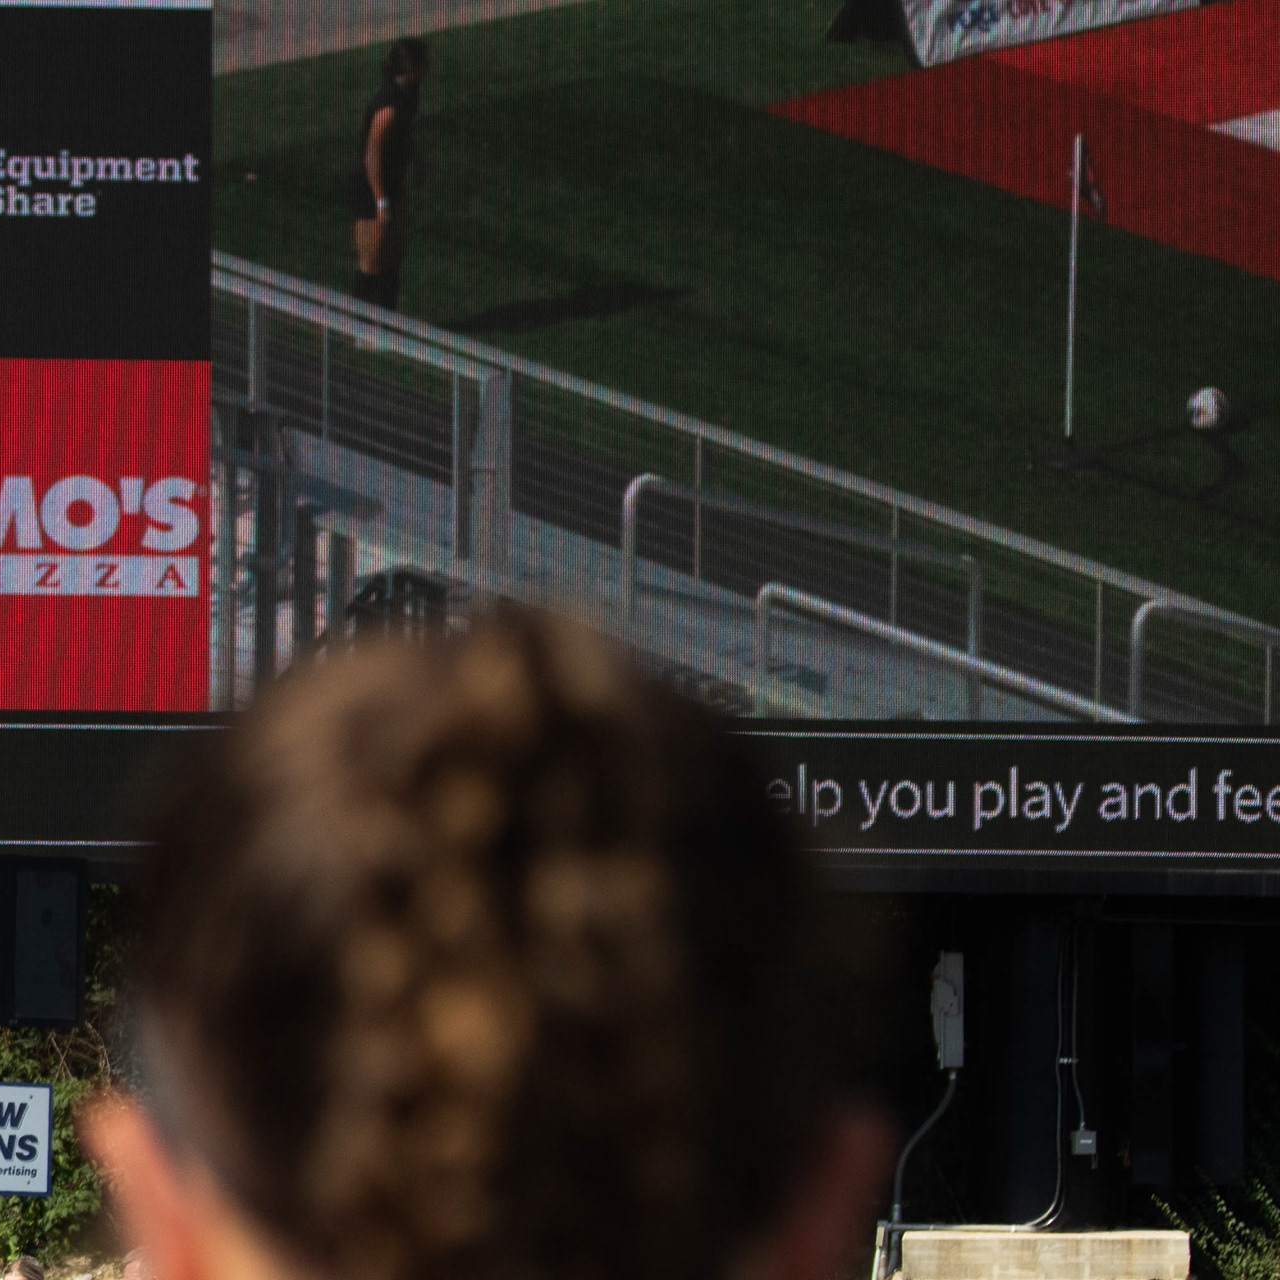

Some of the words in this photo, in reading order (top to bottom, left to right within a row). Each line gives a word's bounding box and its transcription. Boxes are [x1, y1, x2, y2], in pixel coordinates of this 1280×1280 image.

[766, 763, 842, 827] elp
[859, 779, 955, 831] you
[973, 766, 1084, 833] play
[1099, 766, 1198, 821] and
